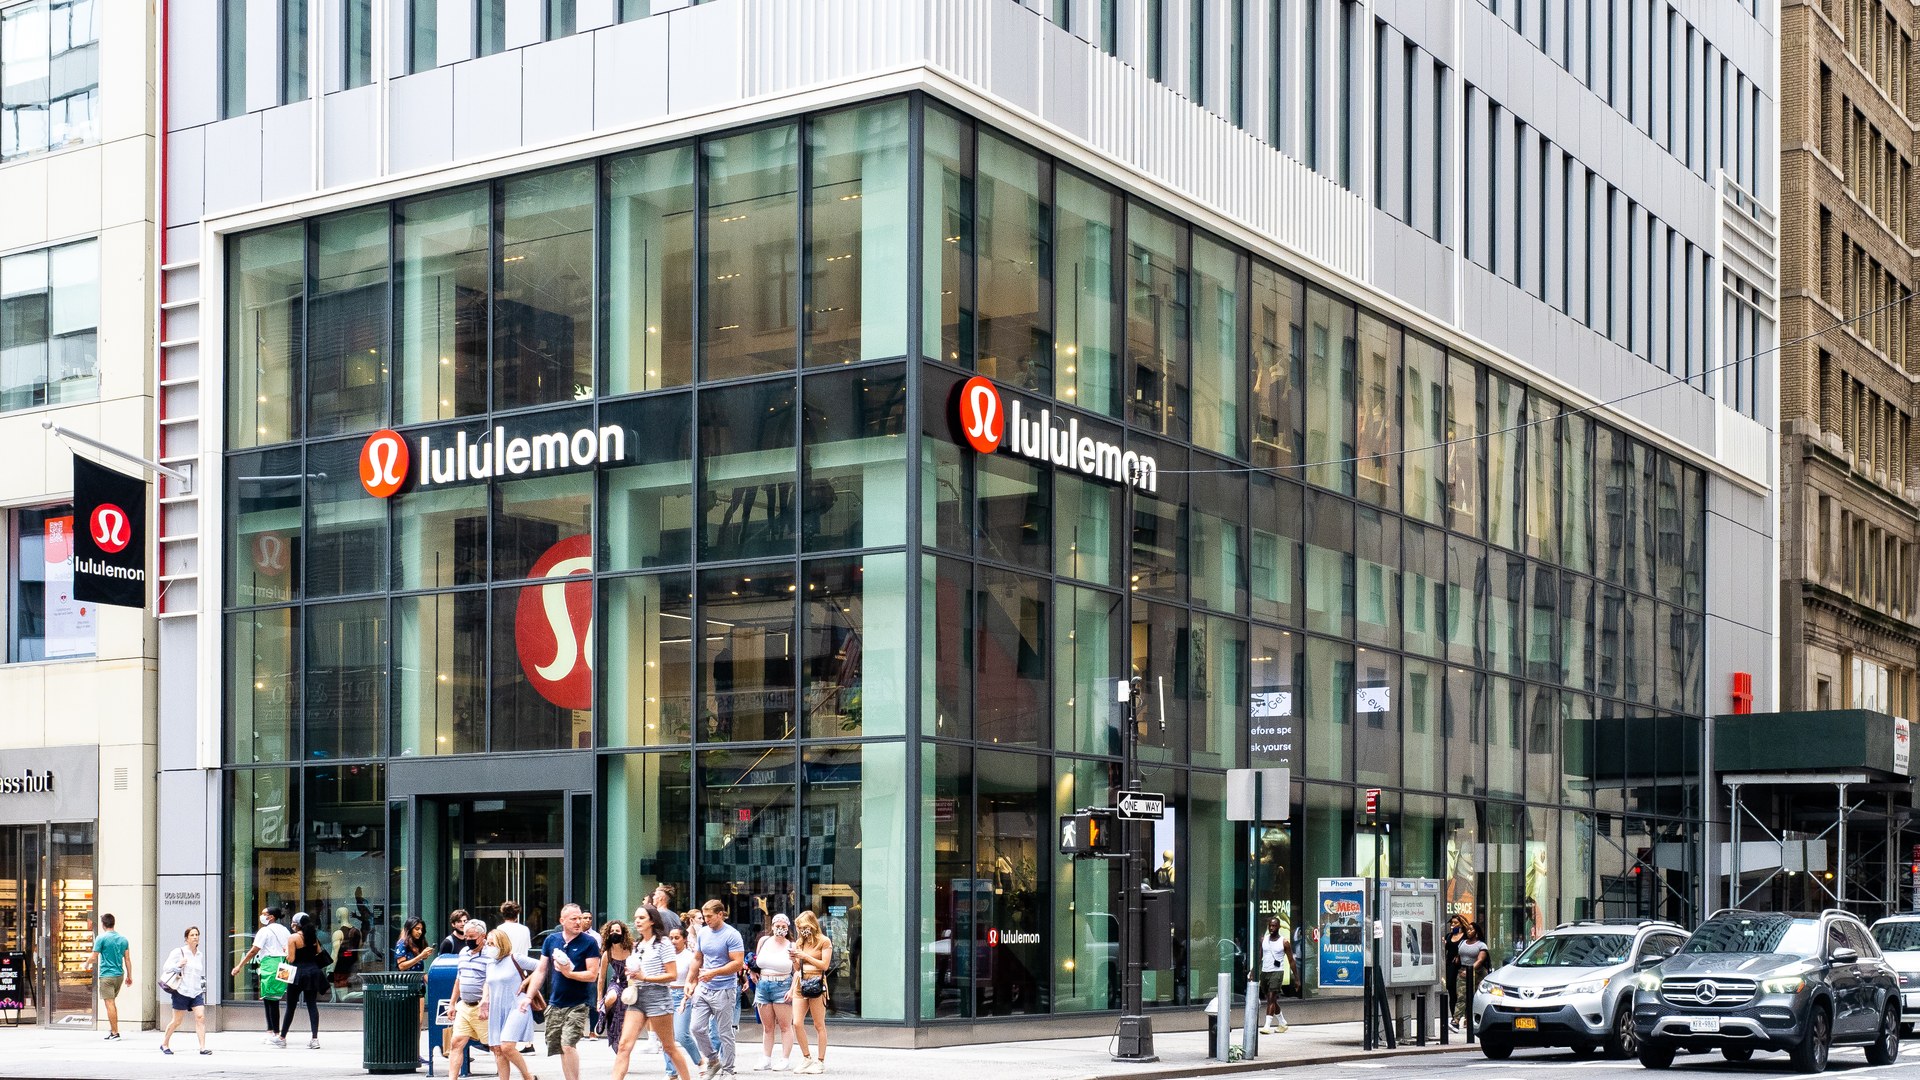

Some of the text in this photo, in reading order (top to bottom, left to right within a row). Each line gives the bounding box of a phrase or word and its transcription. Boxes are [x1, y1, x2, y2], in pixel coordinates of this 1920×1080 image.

[1011, 400, 1157, 492] lululemon
[420, 424, 625, 486] lululemon
[75, 555, 145, 581] lululemon
[1268, 693, 1287, 709] Get
[23, 768, 53, 793] hut
[1124, 801, 1161, 812] ONE WAY
[1336, 901, 1360, 912] MEGA
[1000, 929, 1040, 944] lululemon
[1323, 943, 1363, 953] MILLION
